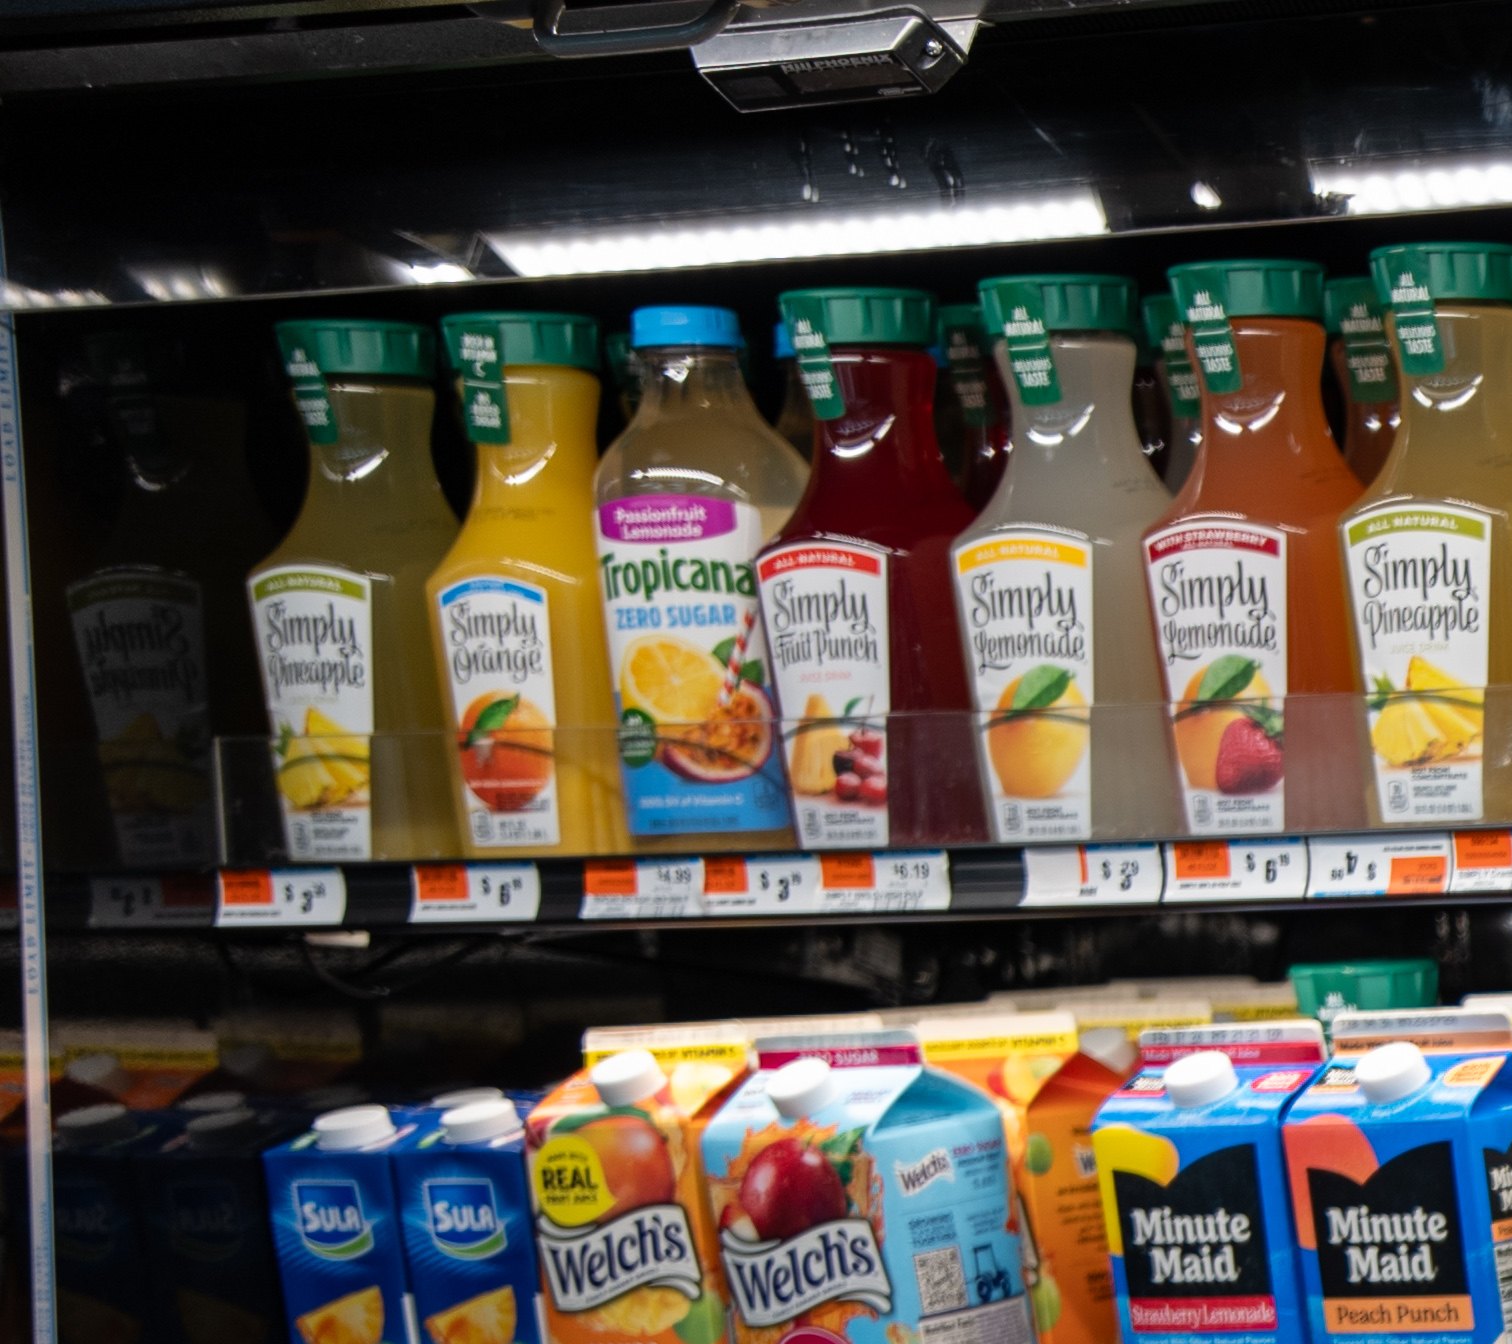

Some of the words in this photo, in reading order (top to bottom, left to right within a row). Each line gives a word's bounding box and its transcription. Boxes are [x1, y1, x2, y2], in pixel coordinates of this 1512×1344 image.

[1368, 519, 1392, 532] ALL
[1396, 517, 1456, 531] NATURAL
[1362, 544, 1474, 601] Simply
[616, 606, 661, 629] ZERO
[668, 606, 736, 628] SUGAR
[1364, 603, 1479, 647] Pineapple
[542, 1168, 598, 1192] REAL
[436, 1199, 495, 1231] SULA
[1328, 1209, 1447, 1244] Minute
[548, 1222, 688, 1291] Welch's
[1348, 1246, 1436, 1282] Maid
[1338, 1303, 1388, 1325] Peach
[1392, 1302, 1459, 1324] Punch
